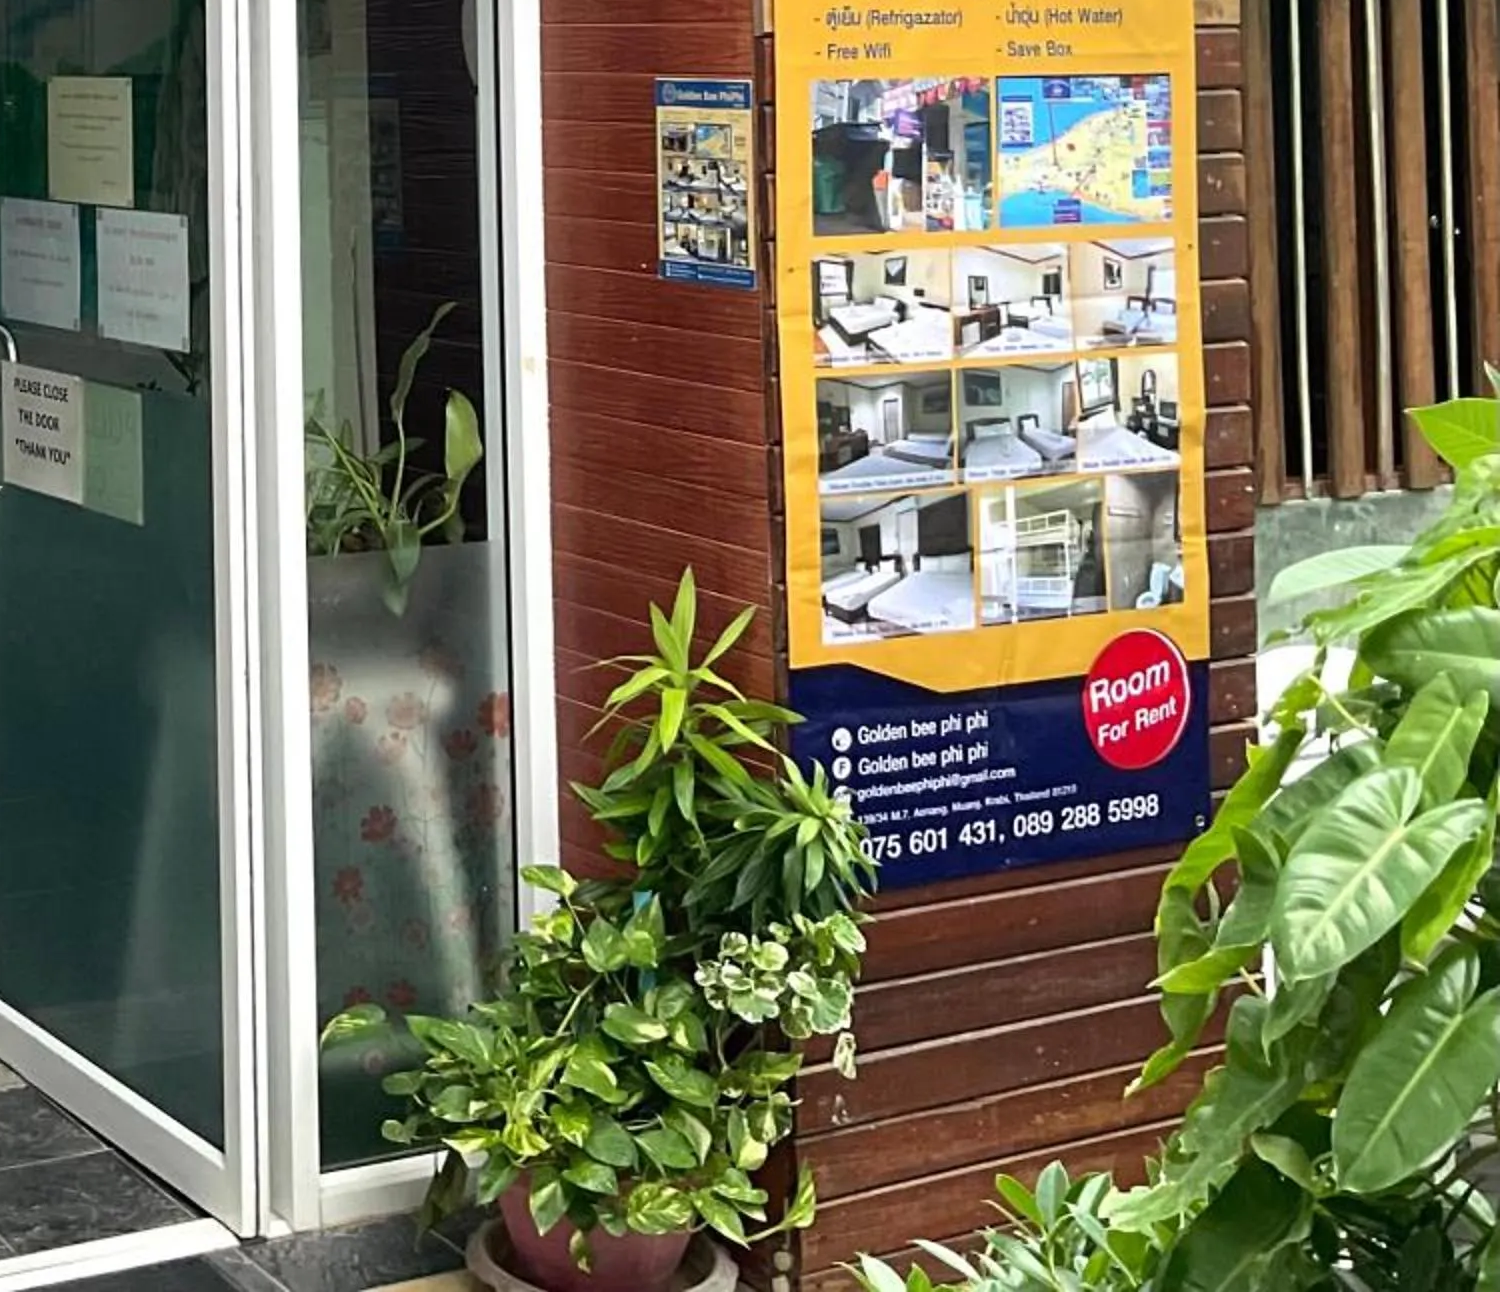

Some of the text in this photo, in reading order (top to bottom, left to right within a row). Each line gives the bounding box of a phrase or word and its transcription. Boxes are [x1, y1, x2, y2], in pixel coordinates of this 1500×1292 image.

[866, 8, 963, 29] (Refrigazator)
[1045, 8, 1072, 27] (Hot
[1077, 8, 1123, 27] Water)
[827, 43, 891, 59] Free Wifi
[1007, 40, 1073, 57] Save Box
[14, 377, 41, 397] PLEASE
[43, 382, 69, 403] CLOSE
[18, 409, 60, 431] THE DOOR
[1089, 659, 1170, 713] Room
[857, 710, 988, 745] Golden bee phi phi
[1098, 696, 1177, 747] For Rent
[857, 754, 908, 775] Golden
[911, 750, 937, 768] bee
[941, 744, 963, 767] phi
[967, 741, 988, 764] phi
[909, 828, 948, 855] 601
[959, 820, 1005, 846] 431,
[1014, 810, 1053, 837] 089
[1062, 803, 1099, 831] 288
[1107, 794, 1159, 823] 5998
